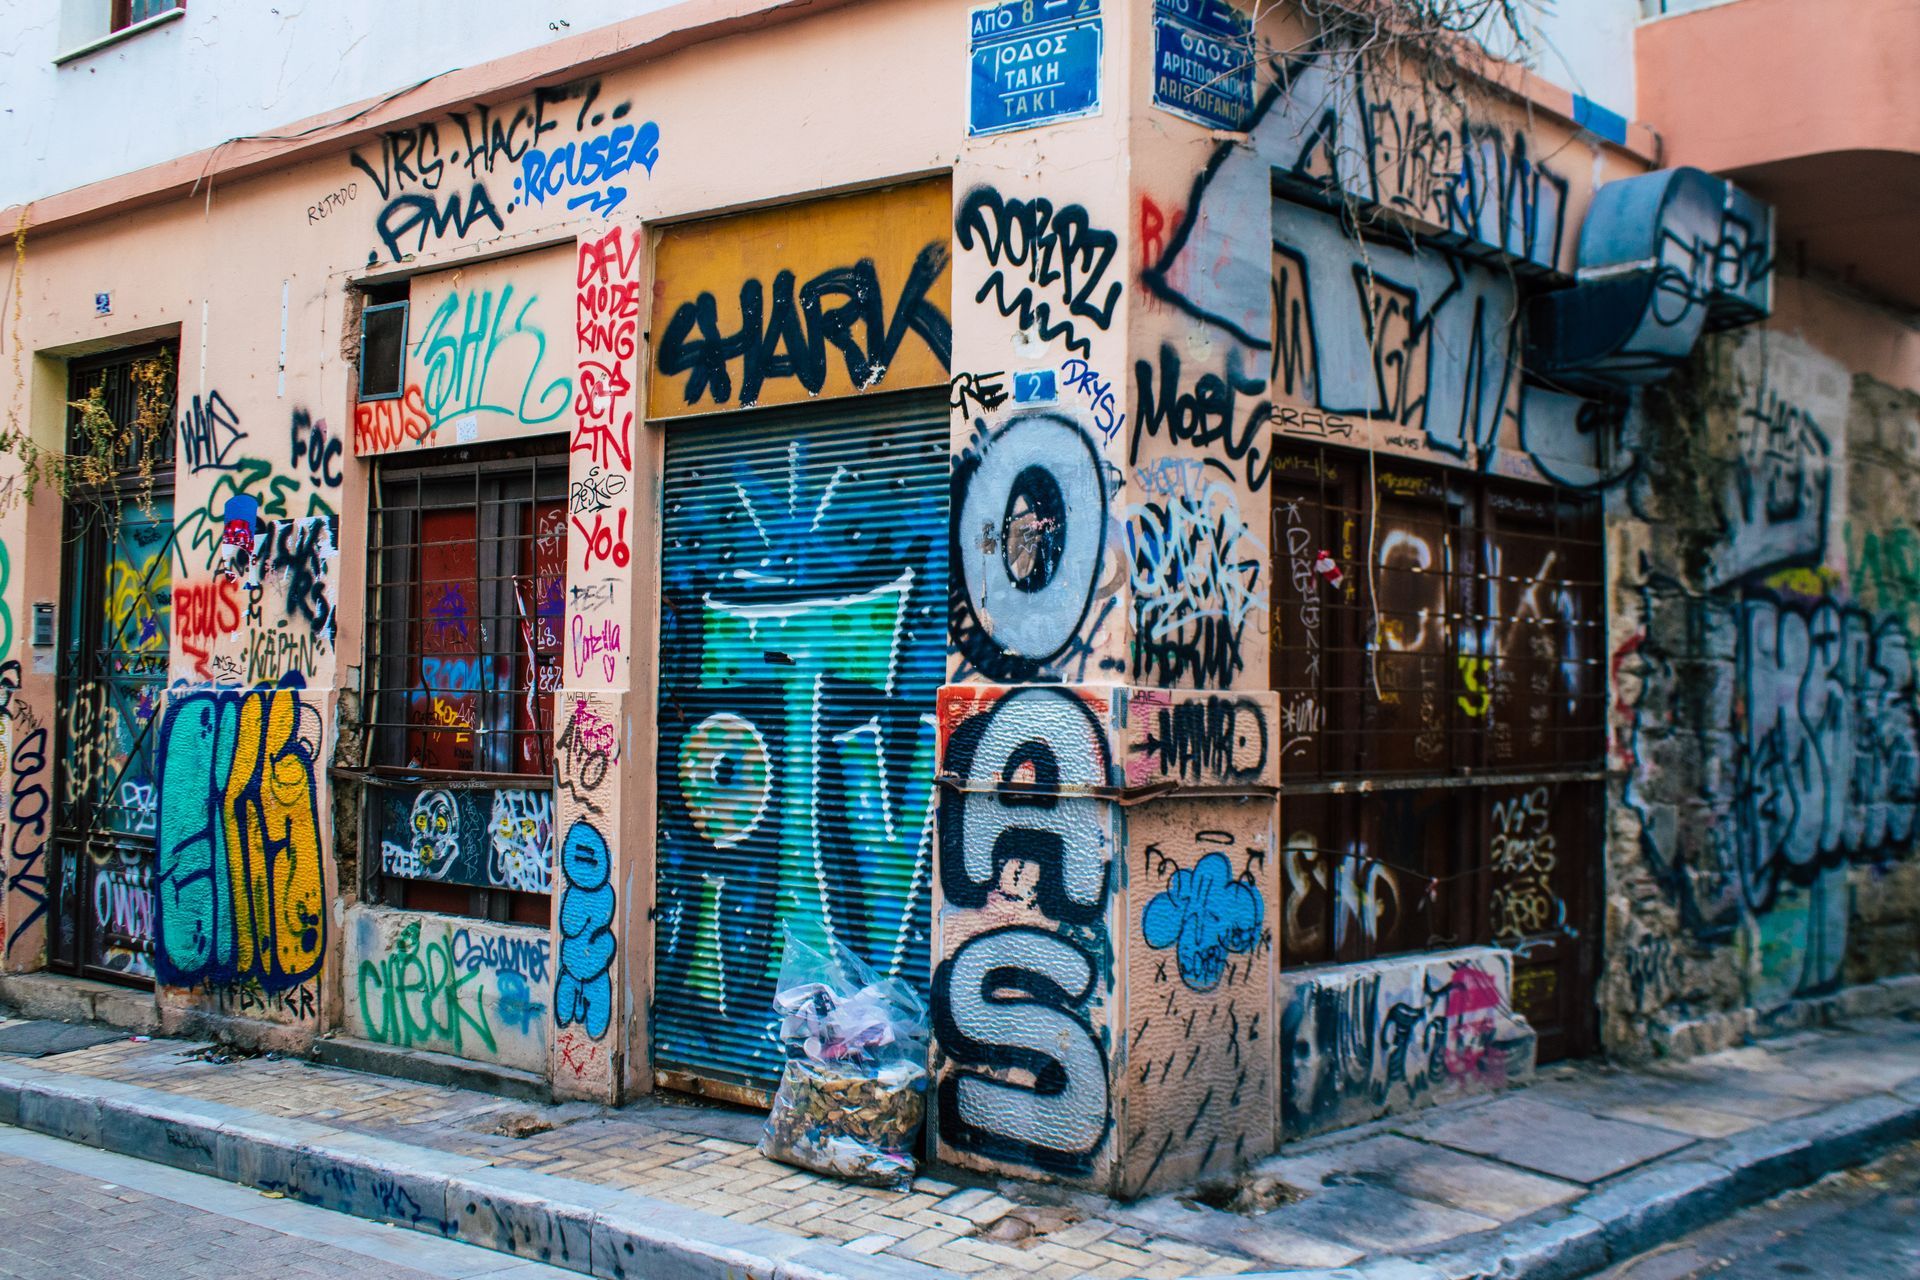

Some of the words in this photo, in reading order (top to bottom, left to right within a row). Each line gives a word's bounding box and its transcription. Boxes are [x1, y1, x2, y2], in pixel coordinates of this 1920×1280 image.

[1001, 35, 1068, 64] ΟΔΟΣ
[1181, 33, 1232, 67] ΟΔΟΣ
[1005, 61, 1060, 89] ΤΑΚΗ
[1004, 91, 1056, 117] TAKI
[657, 238, 952, 408] SHARK
